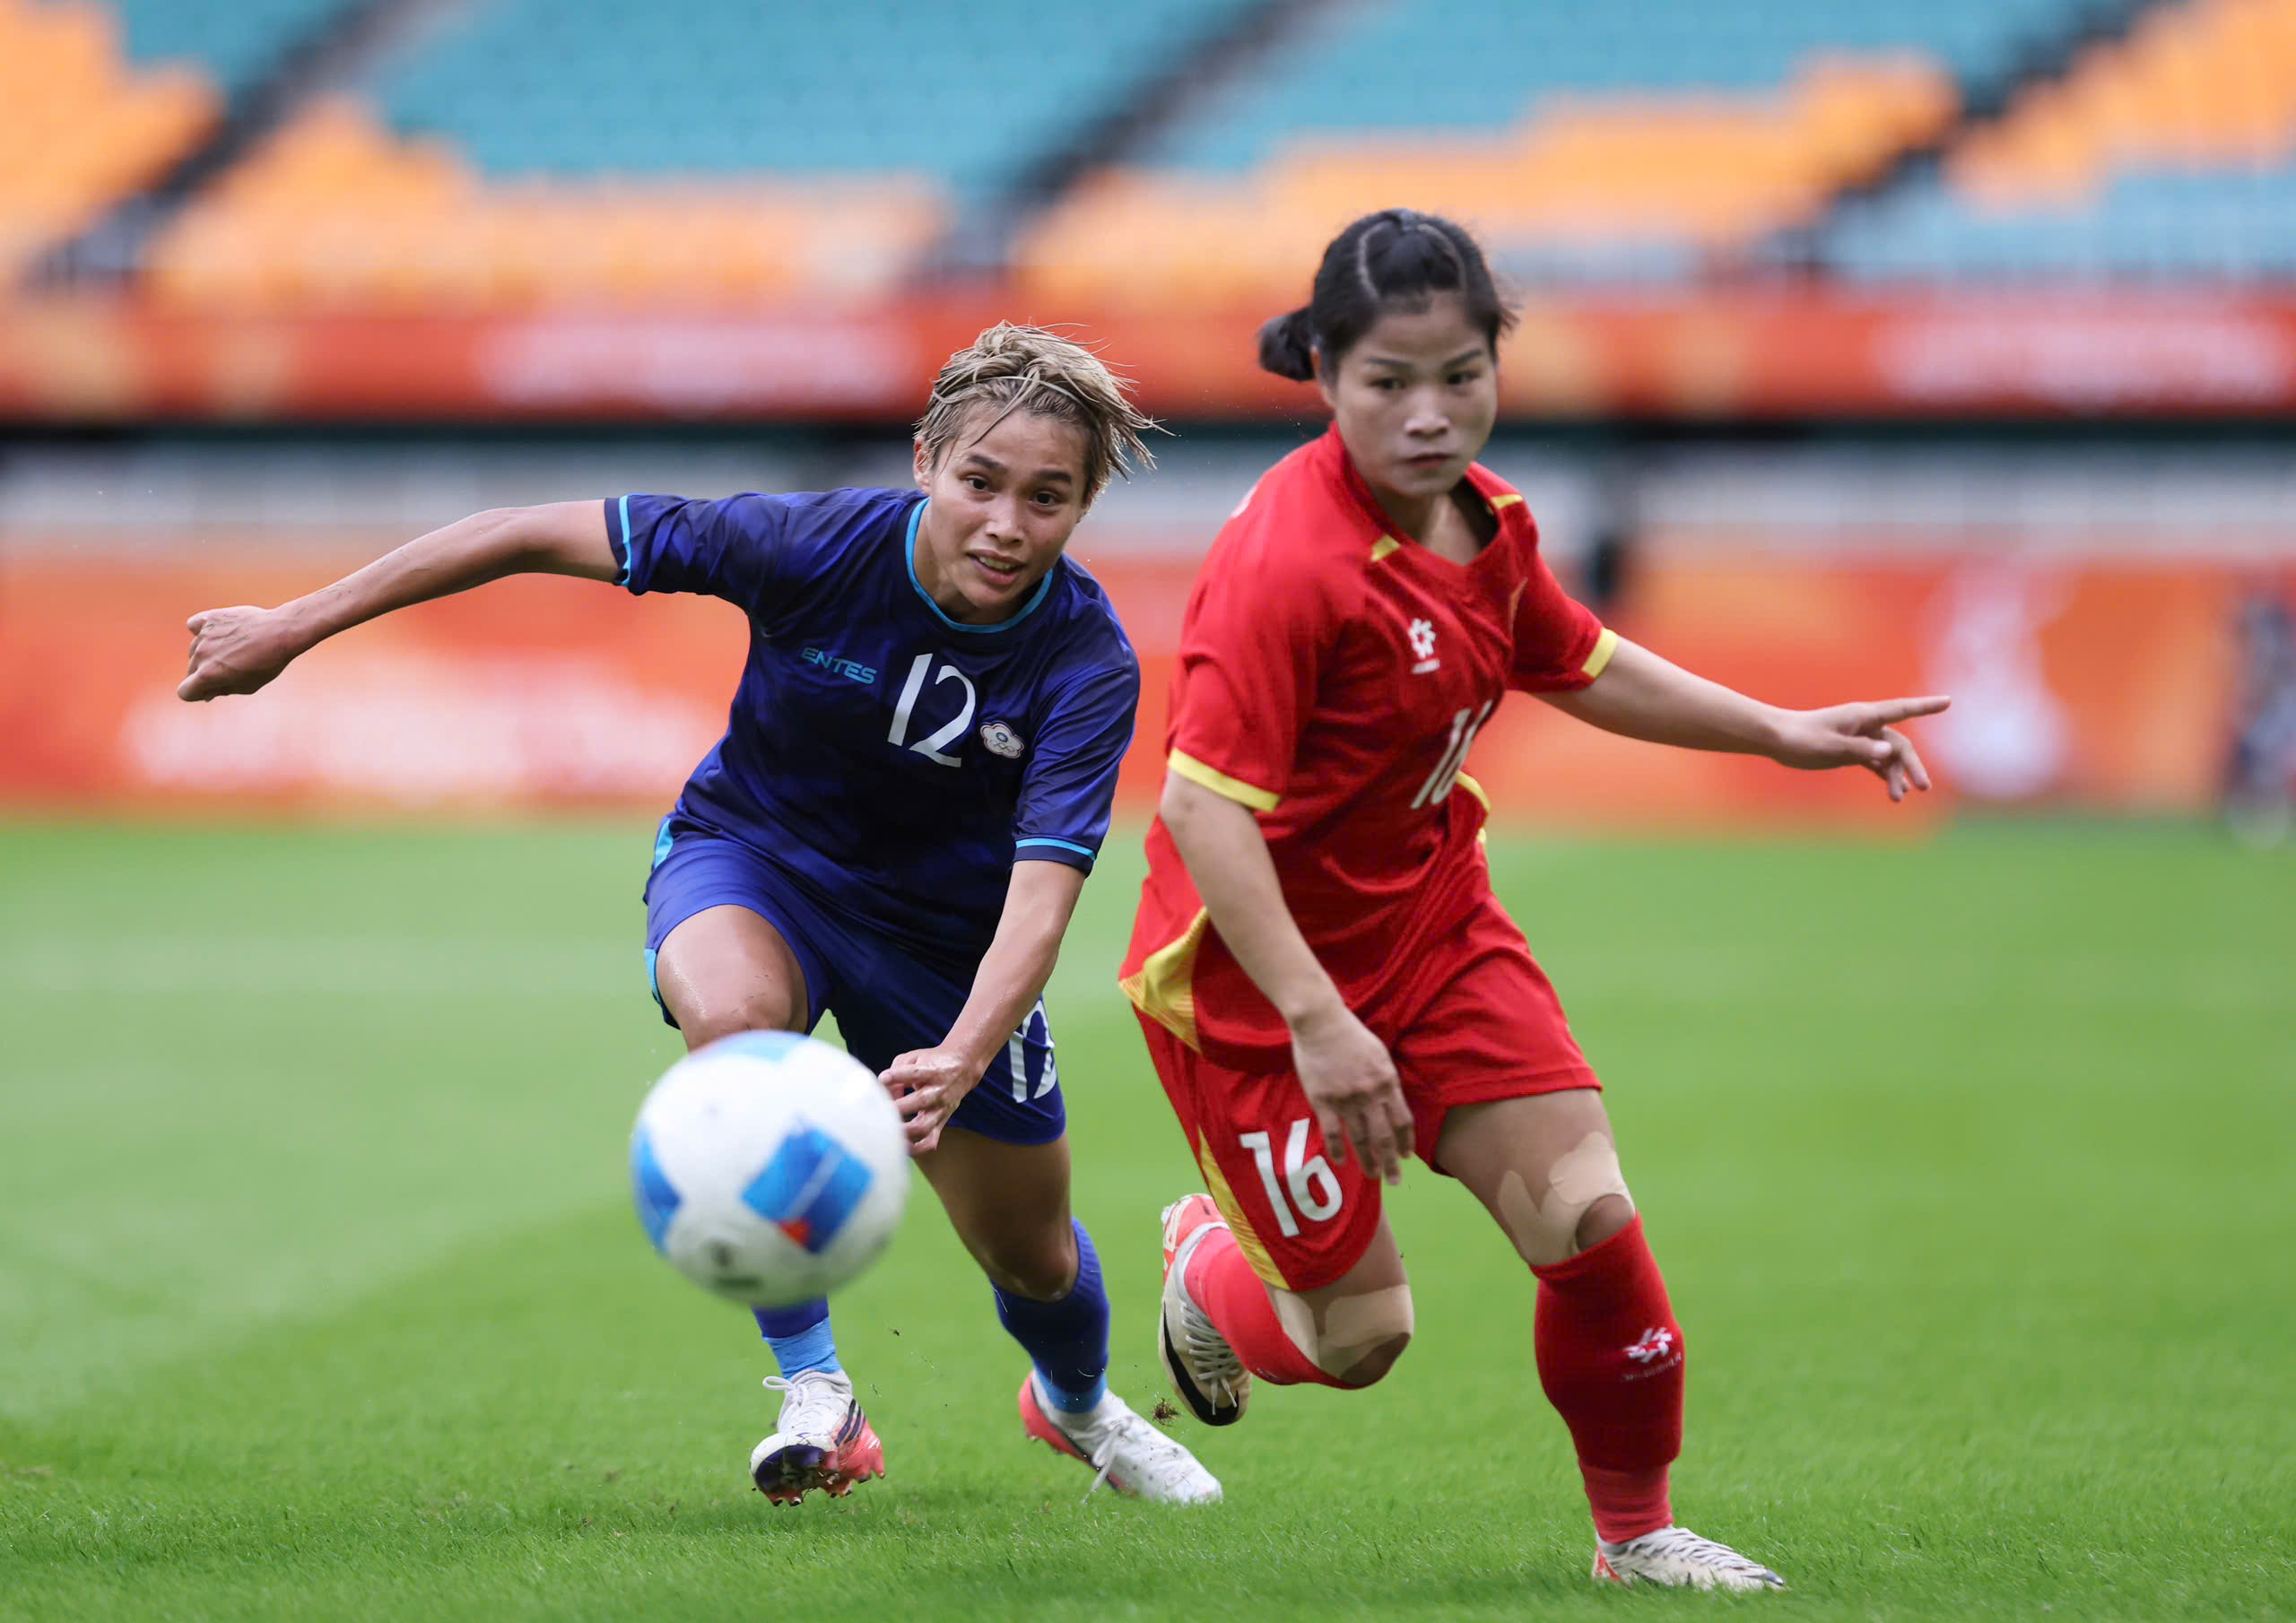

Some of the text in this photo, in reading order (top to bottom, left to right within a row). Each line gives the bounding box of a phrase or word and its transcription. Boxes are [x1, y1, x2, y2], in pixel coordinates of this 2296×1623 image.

[802, 647, 877, 684] ENTES
[887, 653, 976, 768] 12
[1239, 1118, 1344, 1237] 16
